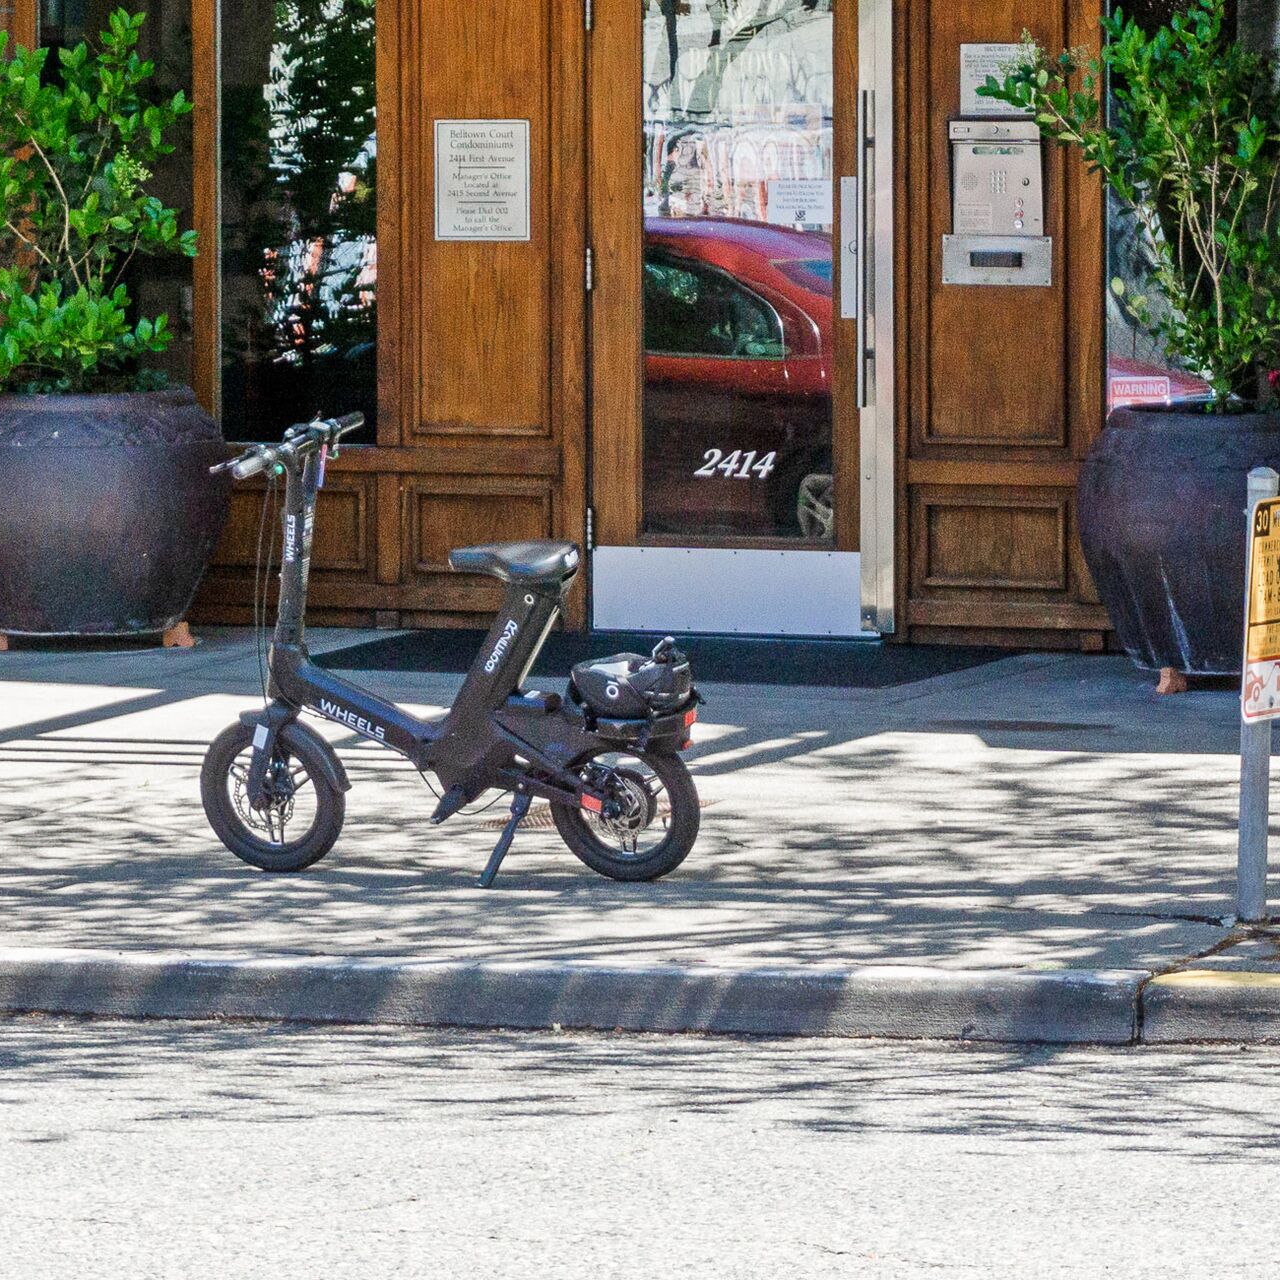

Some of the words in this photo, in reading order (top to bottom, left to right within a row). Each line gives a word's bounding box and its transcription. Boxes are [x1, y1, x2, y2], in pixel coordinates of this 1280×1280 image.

[450, 129, 486, 138] Belltown
[489, 129, 514, 138] Court
[450, 140, 514, 149] Condominiums
[469, 154, 485, 163] First
[488, 154, 515, 162] Avenue
[1114, 383, 1167, 395] WARNING
[693, 448, 776, 478] 2414
[1256, 509, 1269, 532] 30
[286, 514, 295, 561] WHEELS
[321, 699, 385, 739] WHEELS
